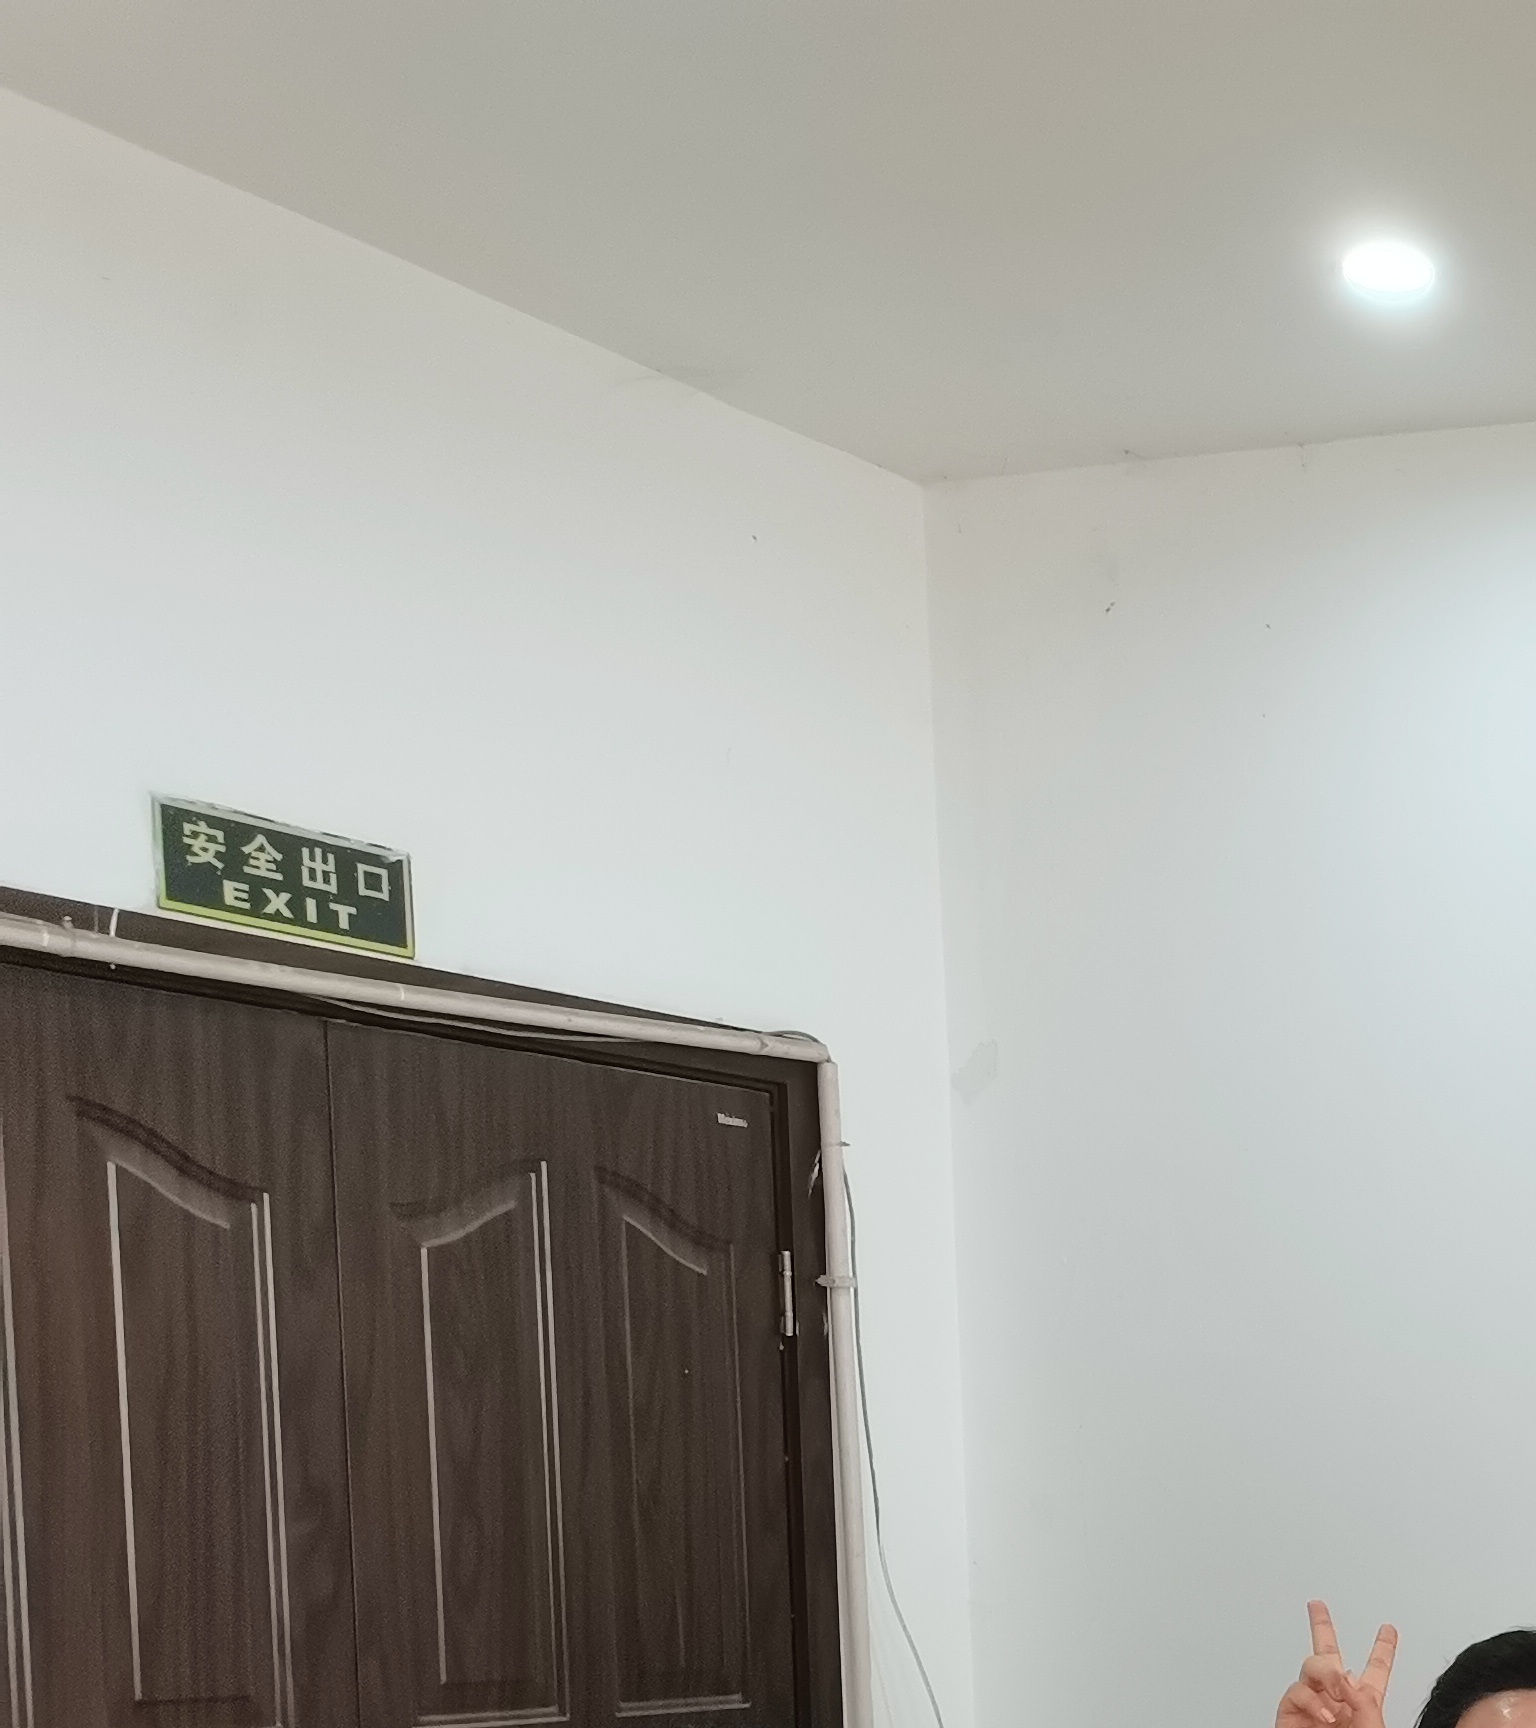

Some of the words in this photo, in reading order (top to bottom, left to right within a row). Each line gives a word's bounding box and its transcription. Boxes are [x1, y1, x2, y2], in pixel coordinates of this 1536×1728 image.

[181, 819, 391, 902] 安全出口
[222, 878, 359, 931] EXIT
